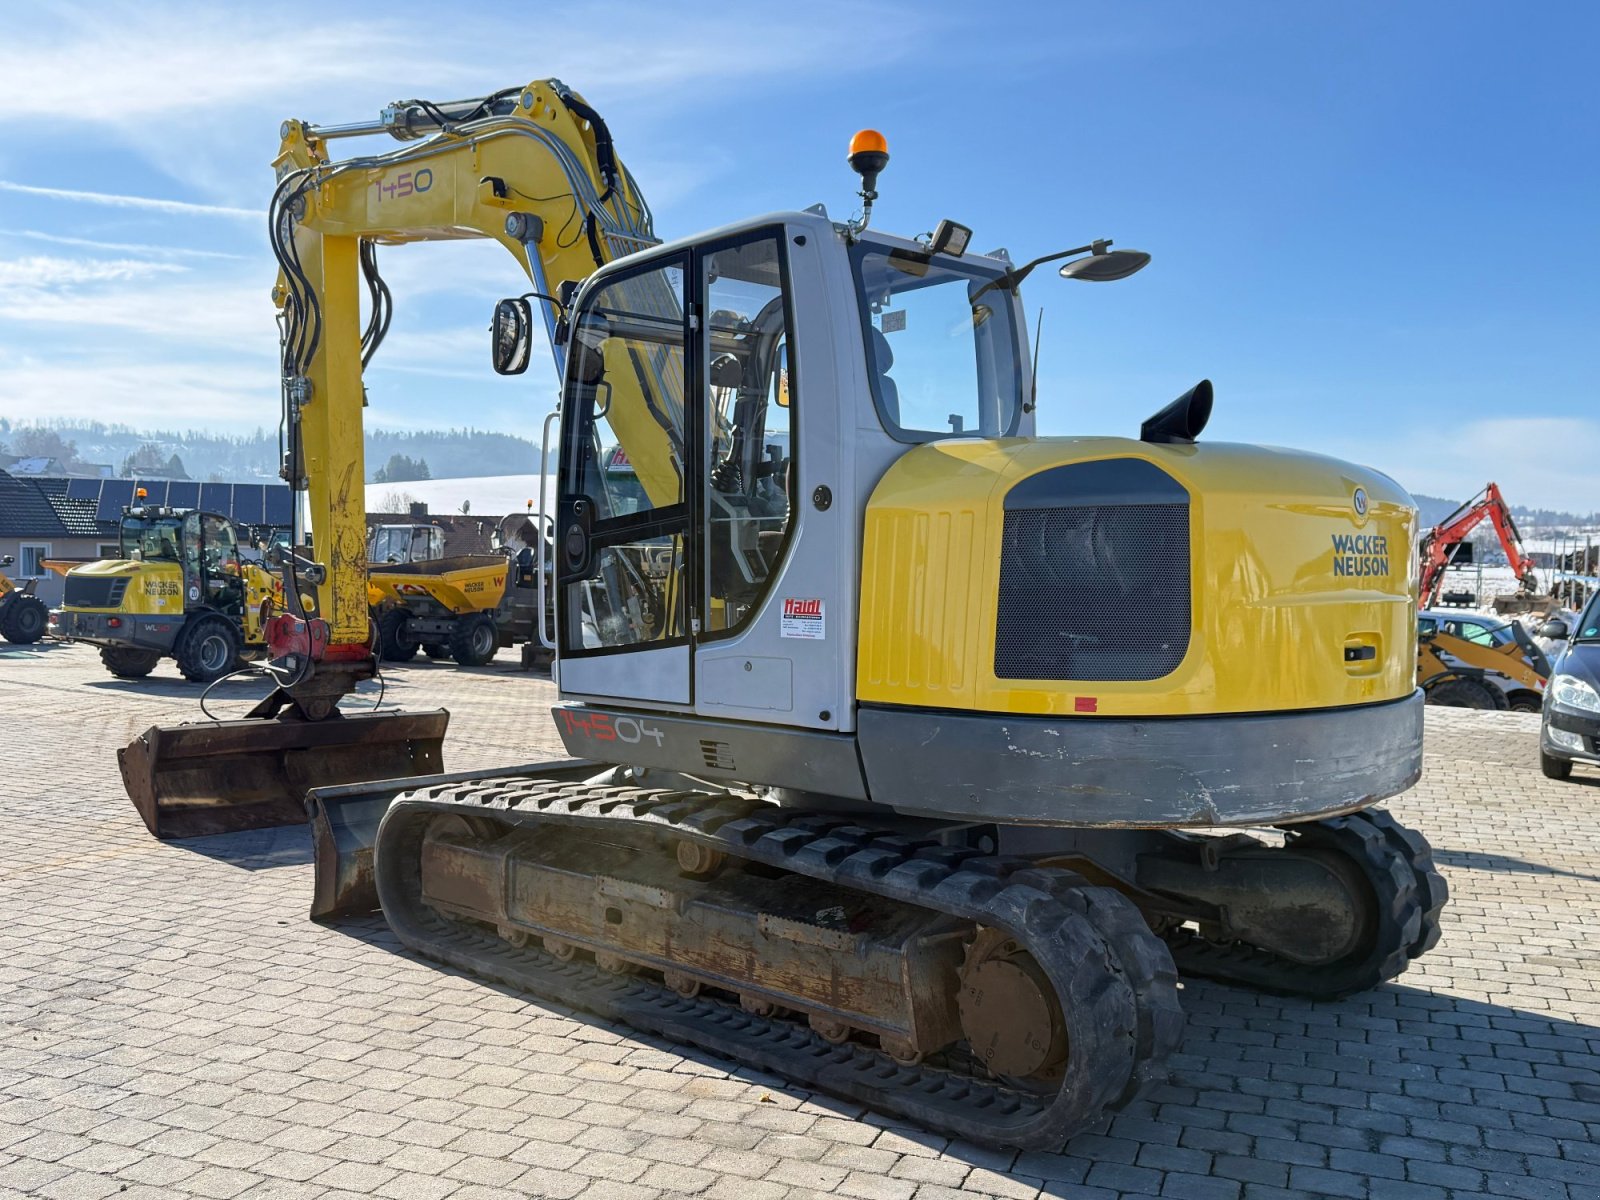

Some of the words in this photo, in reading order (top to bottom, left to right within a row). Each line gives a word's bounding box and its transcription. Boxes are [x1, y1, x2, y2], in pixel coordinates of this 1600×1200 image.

[1331, 534, 1388, 555] WACKER
[1333, 556, 1389, 576] NEUSON
[145, 581, 178, 589] WACKER
[145, 588, 179, 596] NEUSON
[191, 588, 198, 598] 20
[559, 708, 665, 748] 14504
